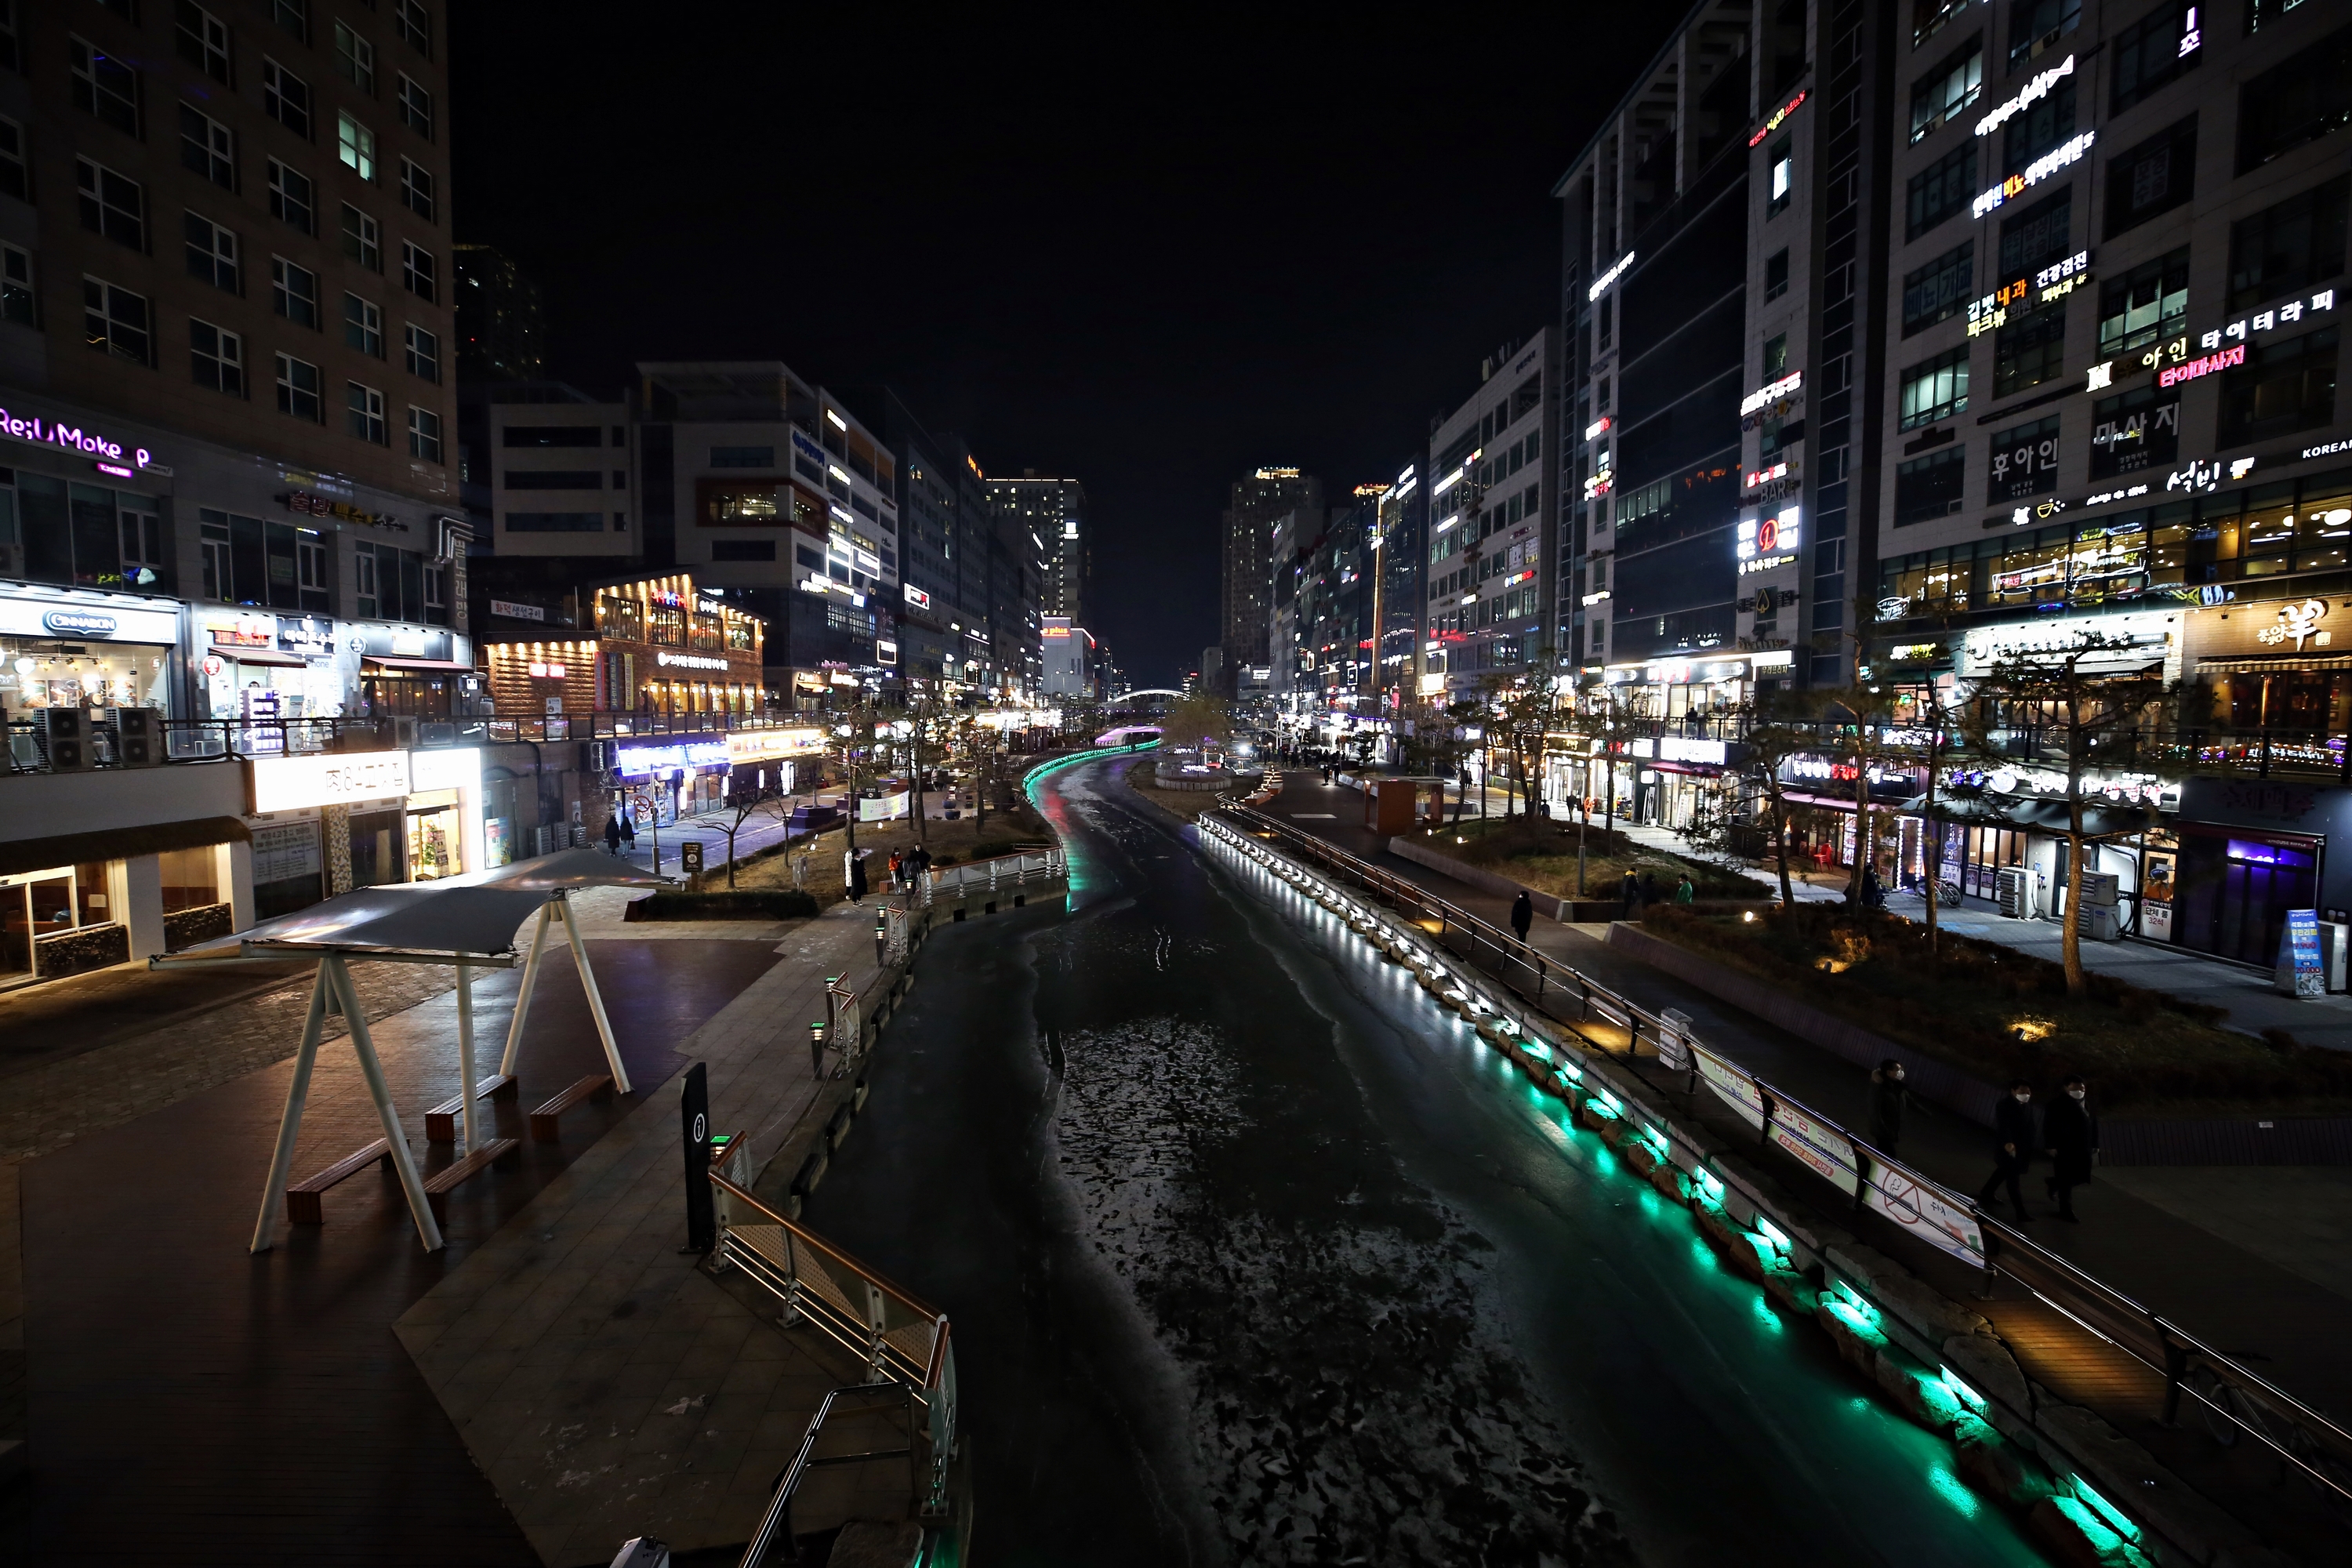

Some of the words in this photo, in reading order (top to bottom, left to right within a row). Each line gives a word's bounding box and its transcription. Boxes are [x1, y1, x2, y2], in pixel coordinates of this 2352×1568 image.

[2037, 250, 2087, 288] 건강검진
[1967, 307, 2006, 338] 파크뷰
[2042, 278, 2074, 302] 피부과
[2201, 289, 2334, 349] 타이테라피
[2158, 345, 2245, 389] 타이마사지
[56, 423, 122, 459] Make
[2096, 401, 2180, 453] 마사지
[1992, 437, 2058, 481] 후아인
[2166, 459, 2220, 493] 설빙
[289, 492, 329, 517] 술탄
[1760, 478, 1787, 503] BAR
[51, 614, 115, 630] CINNABON
[495, 601, 541, 619] 화덕생선구이
[1050, 626, 1069, 635] plus
[2145, 907, 2159, 916] 단체
[2148, 916, 2164, 927] 32석
